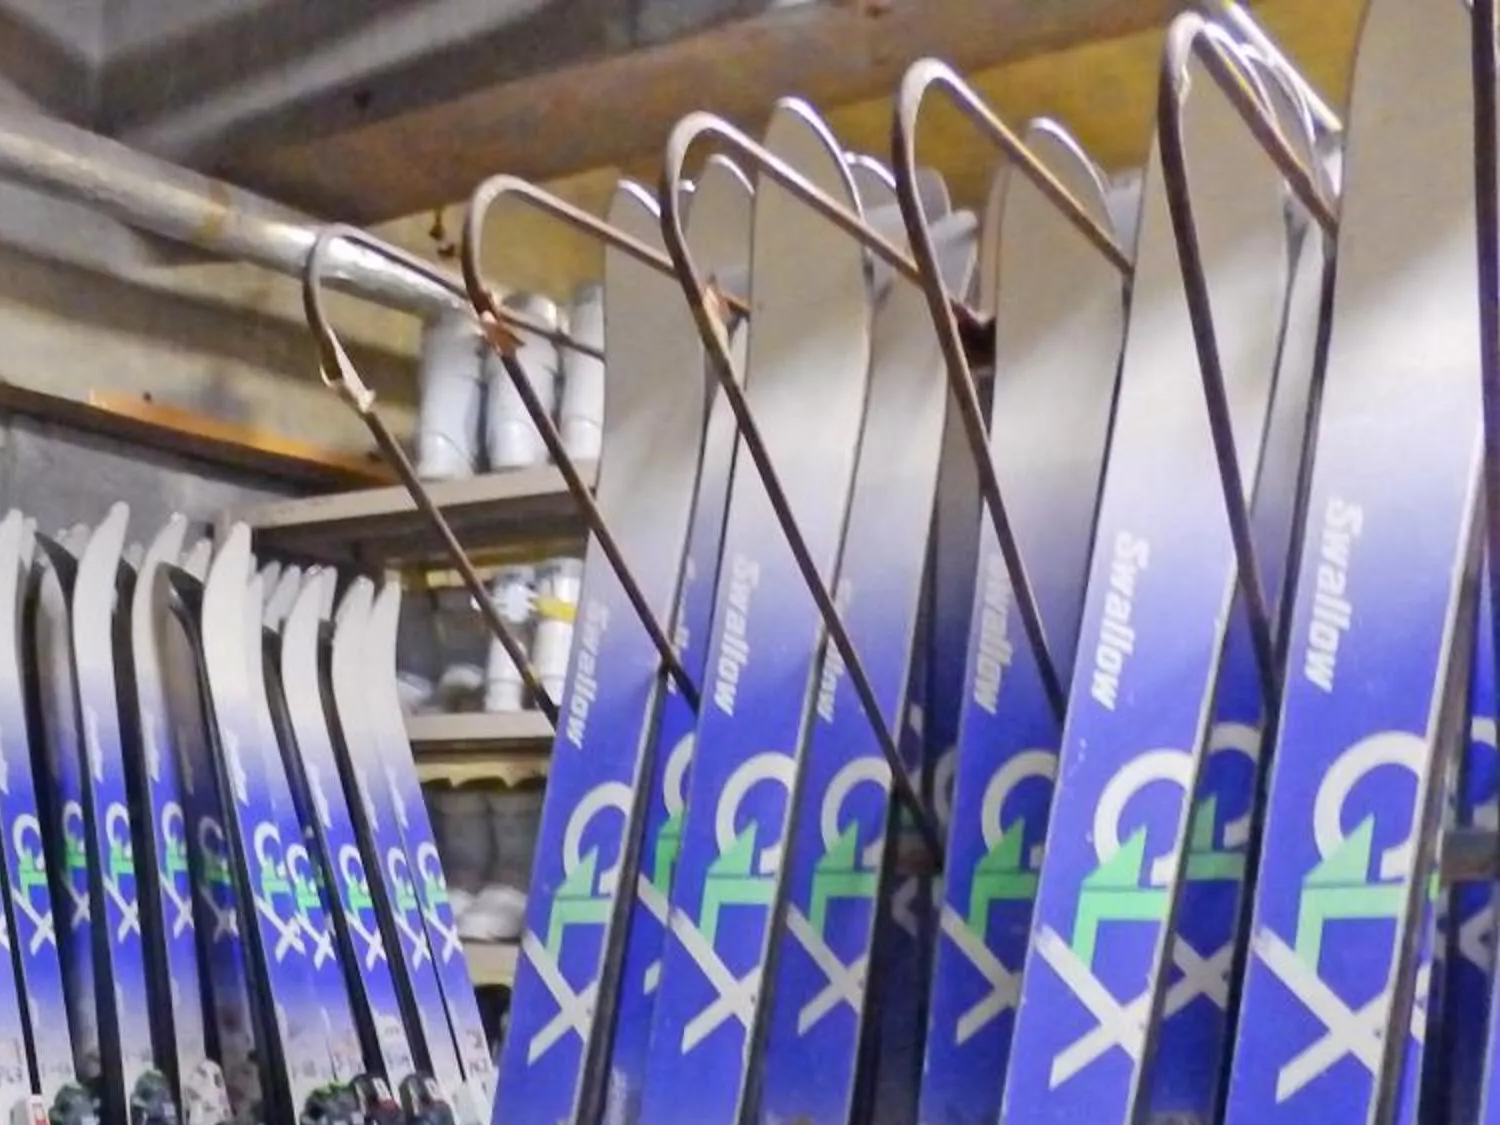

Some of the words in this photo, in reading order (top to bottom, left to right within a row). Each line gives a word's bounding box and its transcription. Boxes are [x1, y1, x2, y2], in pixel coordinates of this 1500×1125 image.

[566, 603, 610, 750] Swallow
[713, 554, 760, 718] Swallow
[1090, 532, 1150, 711] Swallow
[1304, 497, 1362, 692] Swallow
[670, 751, 796, 1054] GLX
[787, 756, 894, 1036] GLX
[1033, 748, 1195, 1090] GLX
[1252, 731, 1427, 1103] GLX
